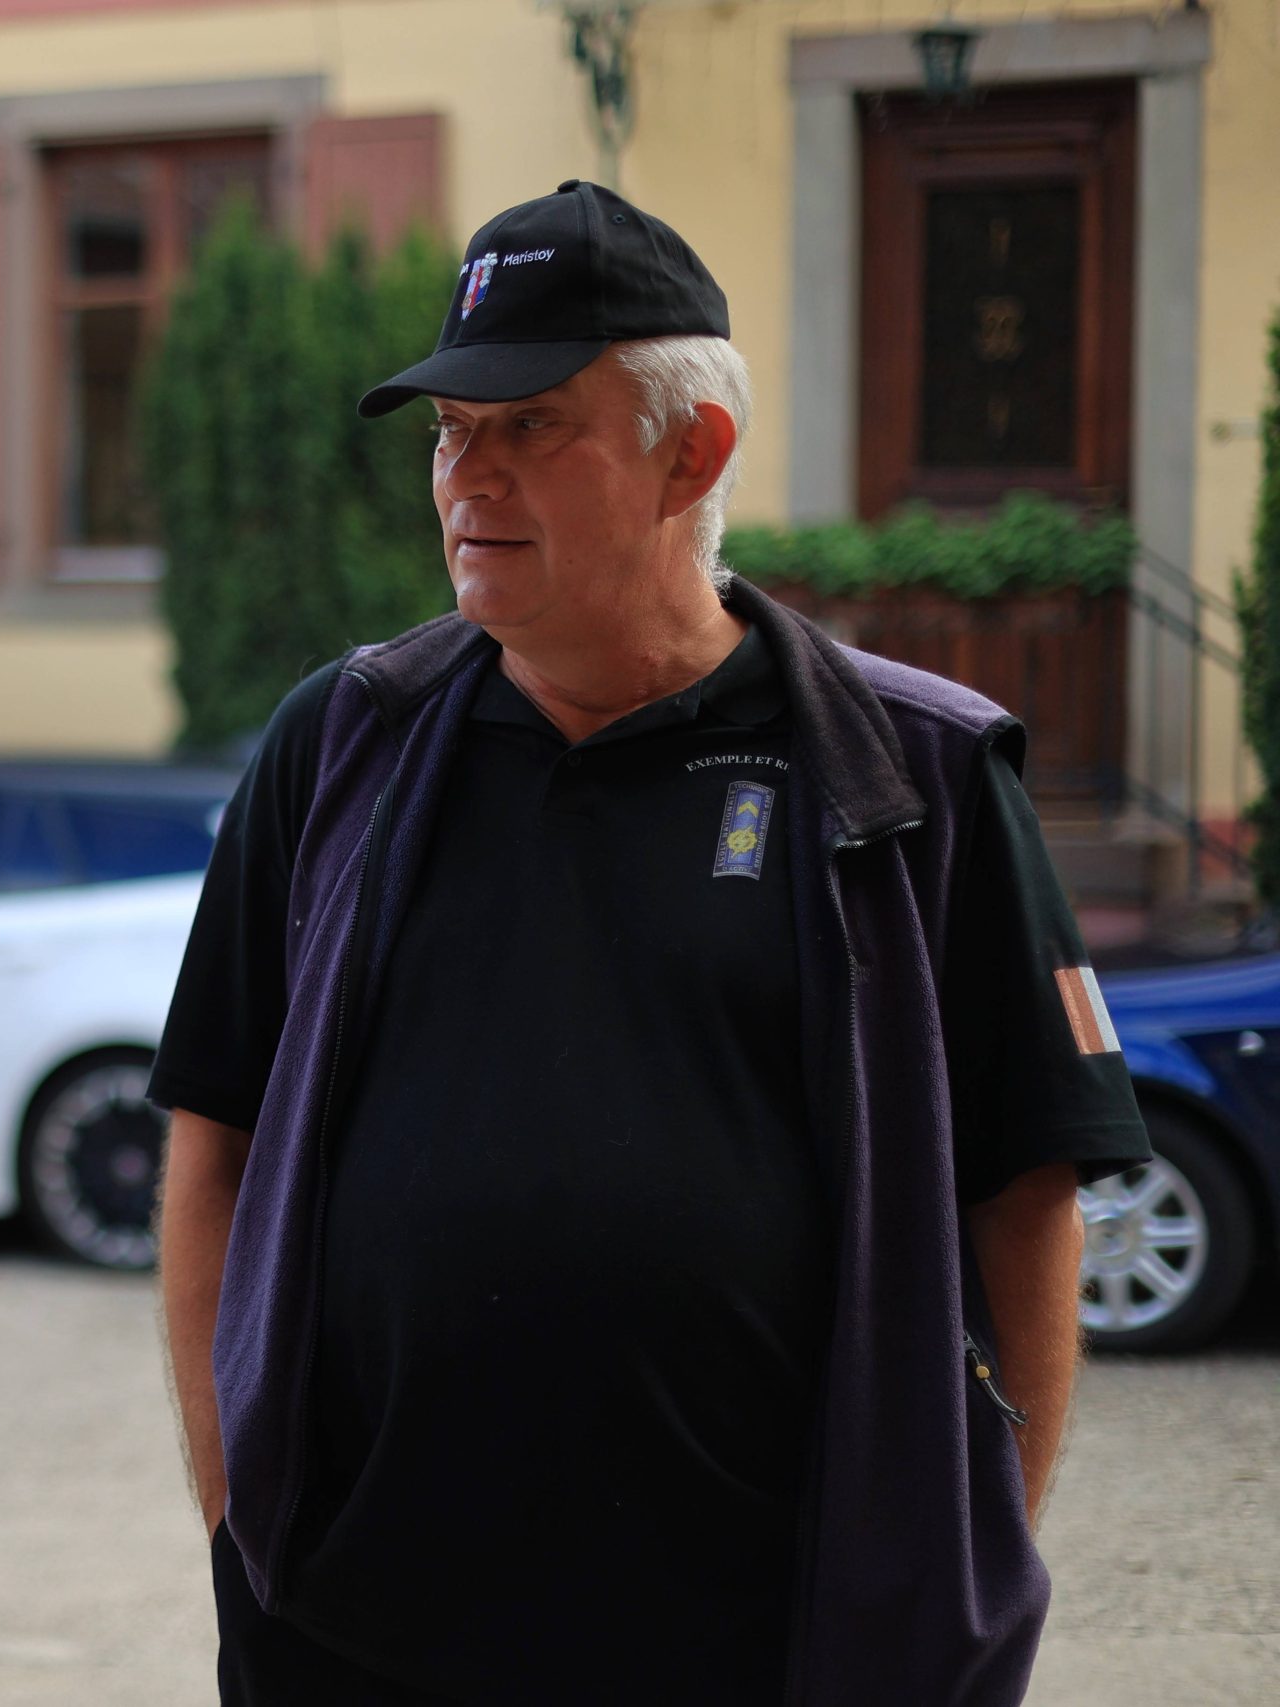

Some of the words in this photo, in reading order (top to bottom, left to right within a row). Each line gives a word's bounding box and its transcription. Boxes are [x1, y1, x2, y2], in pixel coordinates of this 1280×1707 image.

[502, 249, 555, 267] Haristoy
[685, 755, 752, 772] EXEMPLE
[755, 756, 773, 765] ET
[775, 758, 790, 773] RI
[723, 790, 736, 839] NATIONALE
